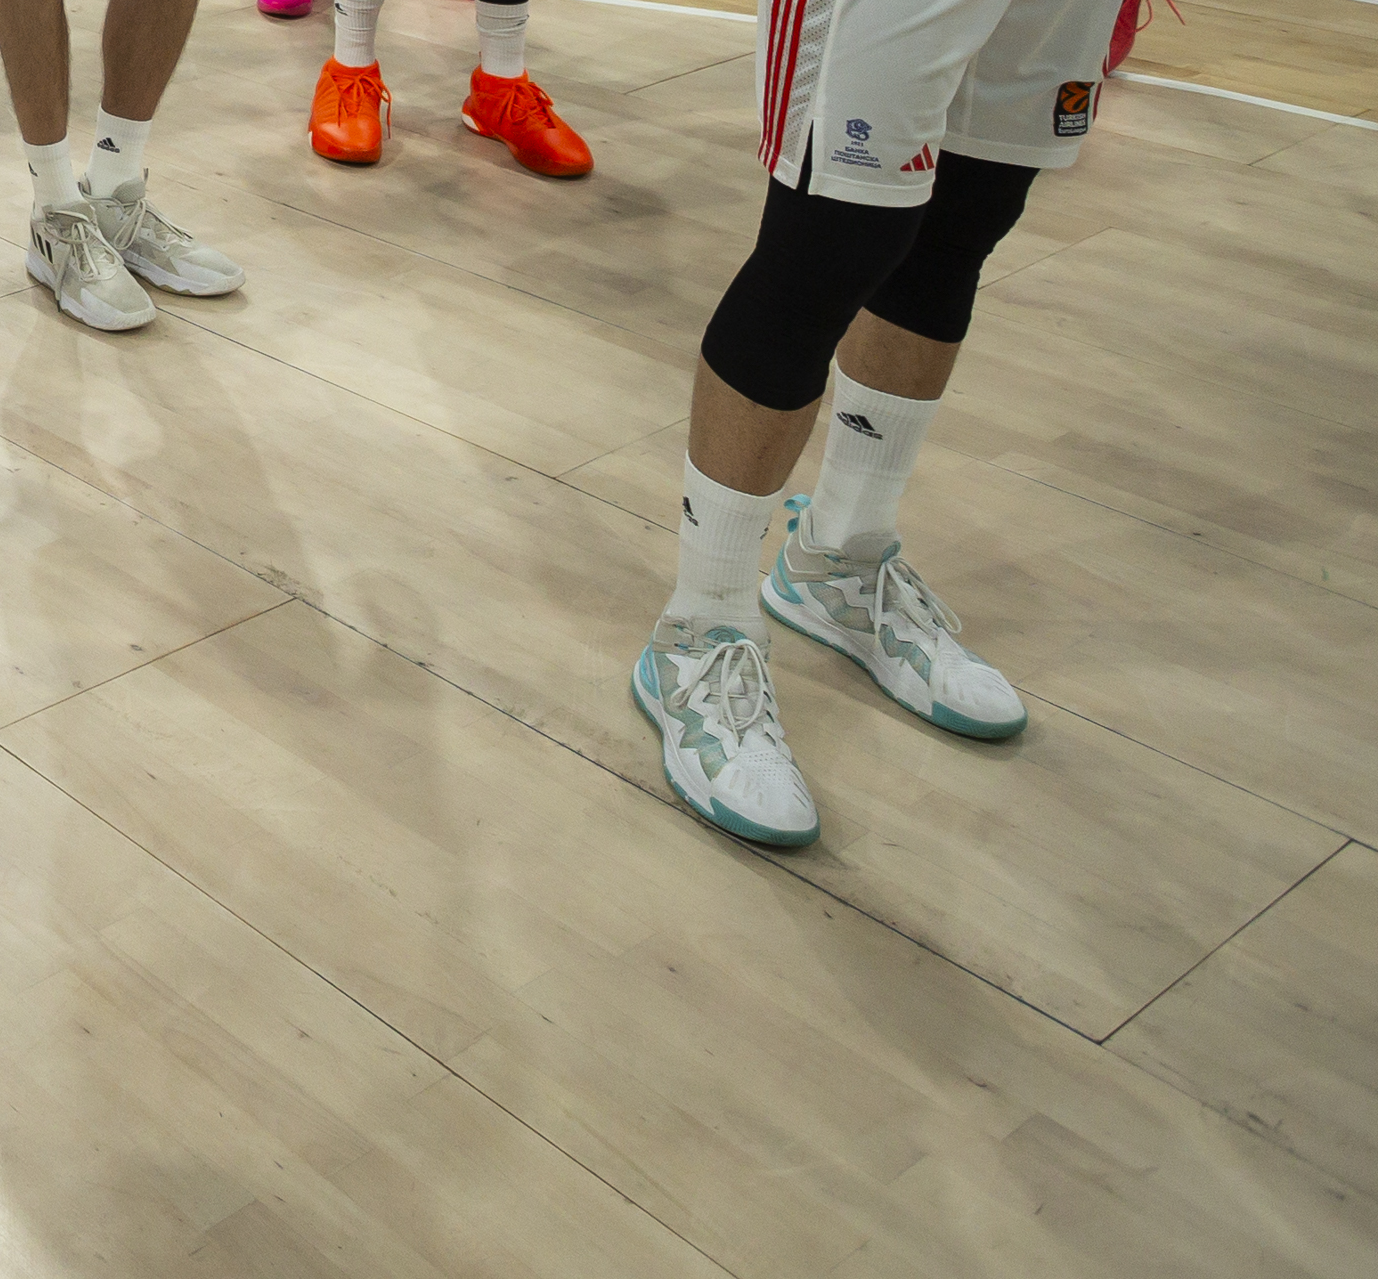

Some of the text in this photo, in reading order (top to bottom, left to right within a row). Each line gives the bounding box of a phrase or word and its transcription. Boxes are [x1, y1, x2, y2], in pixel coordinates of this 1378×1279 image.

[834, 150, 879, 163] ПОШТАНСКА
[845, 147, 869, 155] БАНКА
[831, 156, 882, 170] ШТЕДИОНИЦА
[834, 412, 882, 440] adidas
